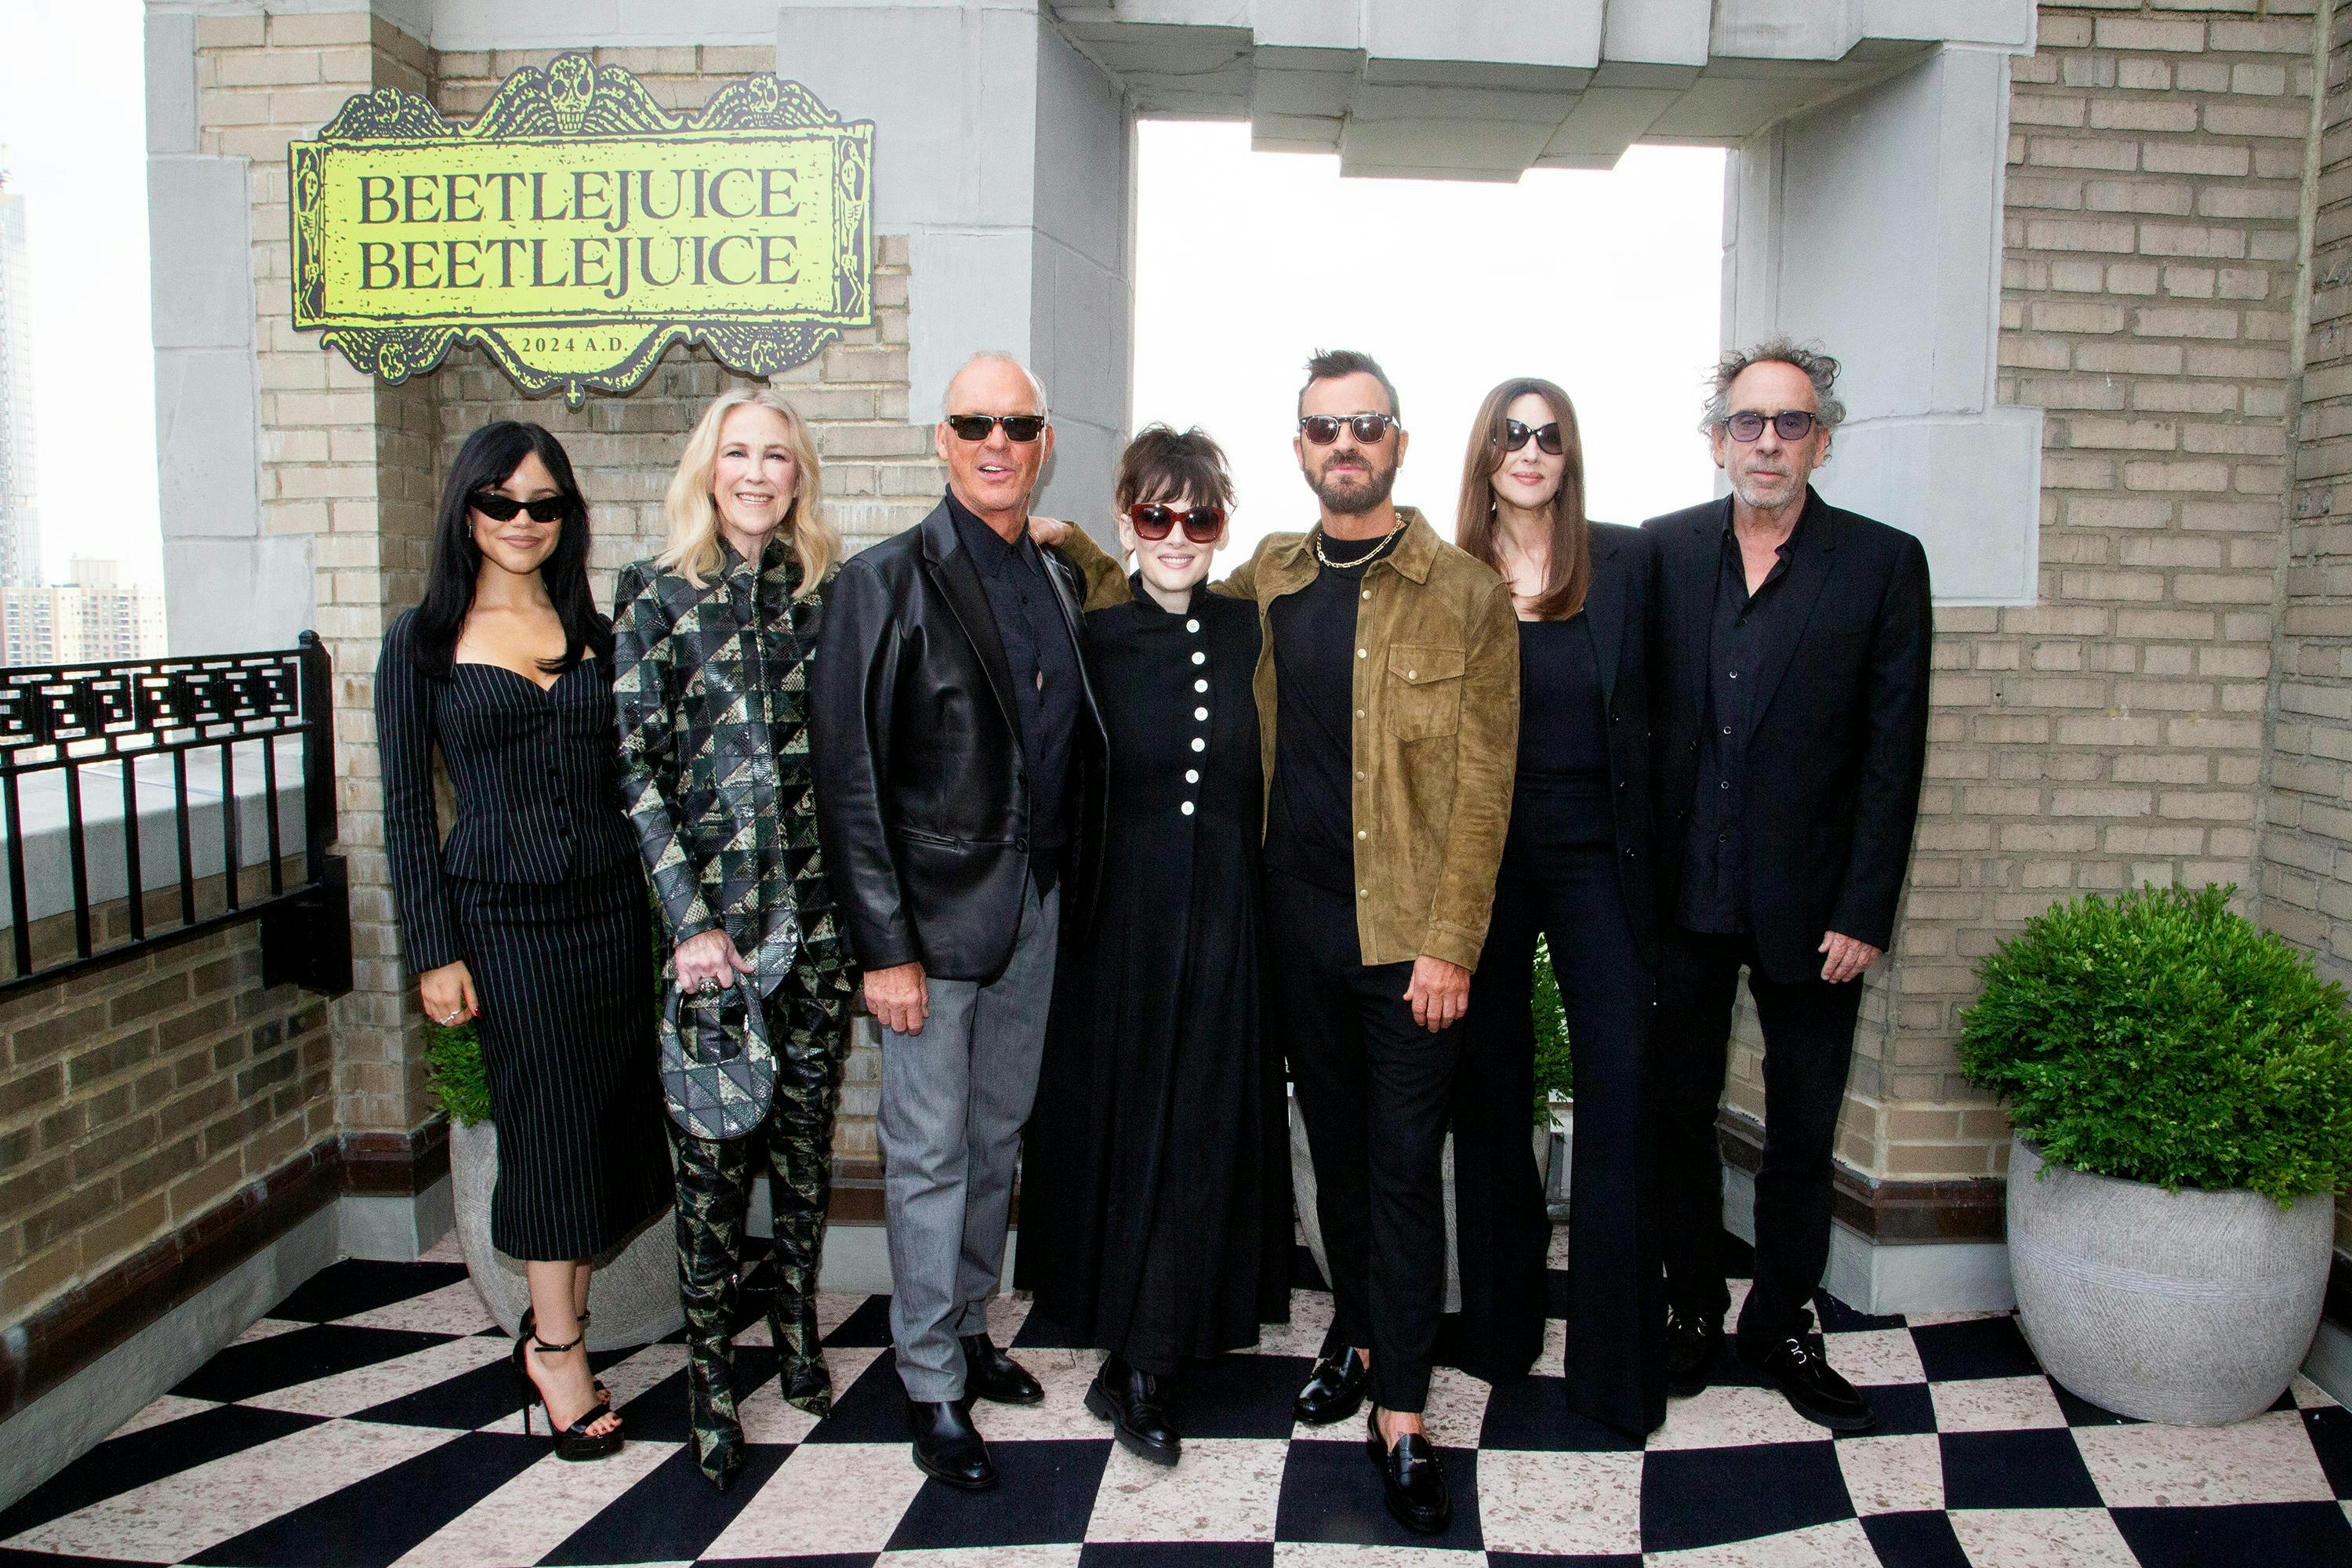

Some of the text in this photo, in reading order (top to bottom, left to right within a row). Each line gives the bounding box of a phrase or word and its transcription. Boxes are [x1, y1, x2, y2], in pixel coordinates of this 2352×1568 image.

[358, 168, 800, 233] BEETLEJUICE
[358, 235, 800, 299] BEETLEJUICE
[522, 337, 628, 352] 2024 A.D.
